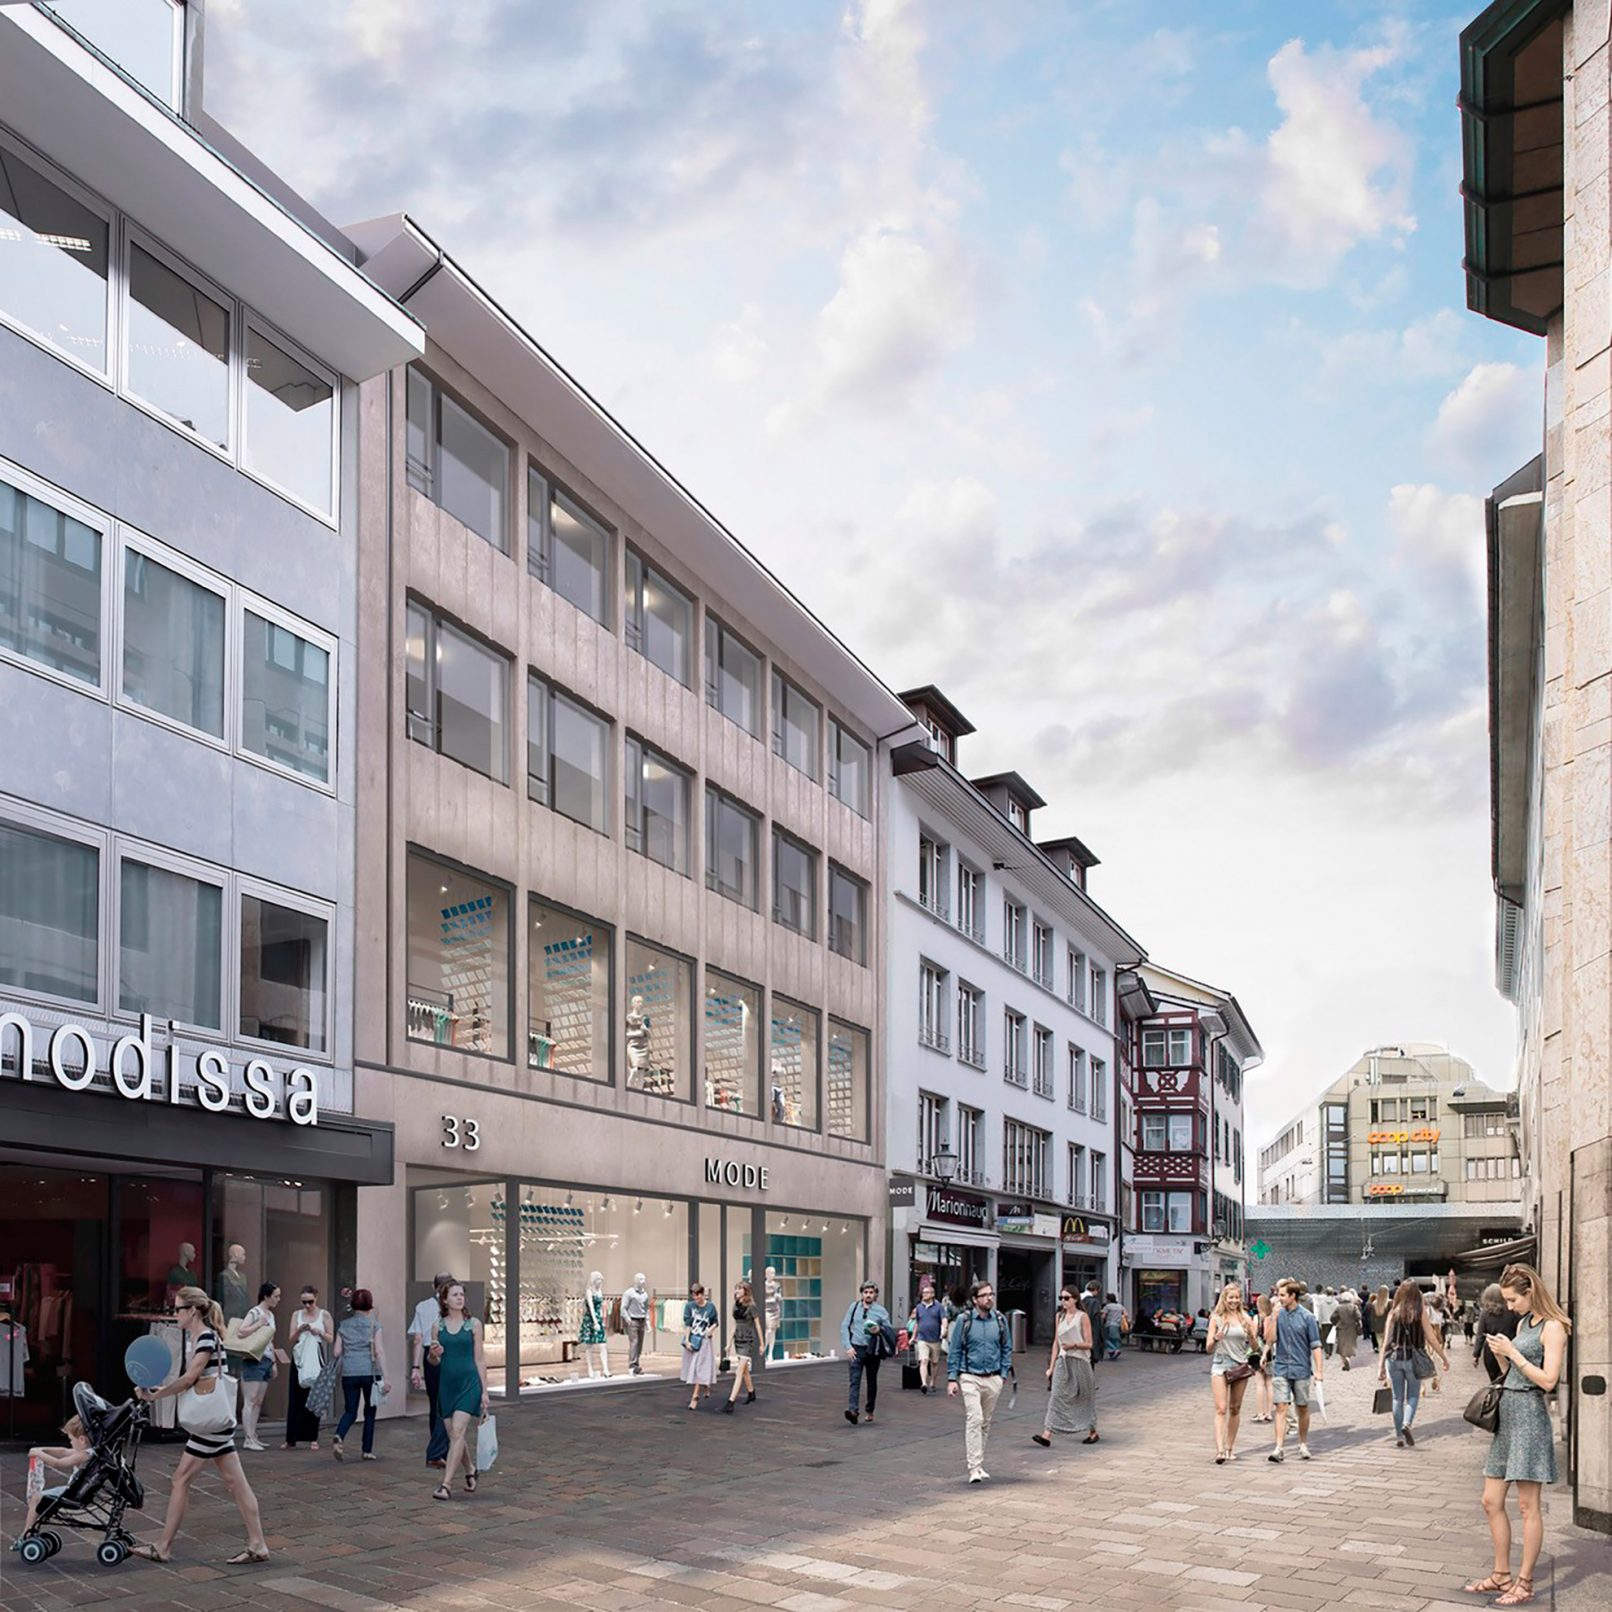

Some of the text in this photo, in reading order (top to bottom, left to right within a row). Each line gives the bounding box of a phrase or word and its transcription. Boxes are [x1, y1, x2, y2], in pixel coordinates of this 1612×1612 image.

[441, 1116, 481, 1151] 33
[1367, 1127, 1441, 1146] coop city
[705, 1158, 769, 1190] MODE
[889, 1186, 913, 1195] MODE
[1370, 1184, 1404, 1195] coop
[926, 1186, 989, 1220] Marionnaud
